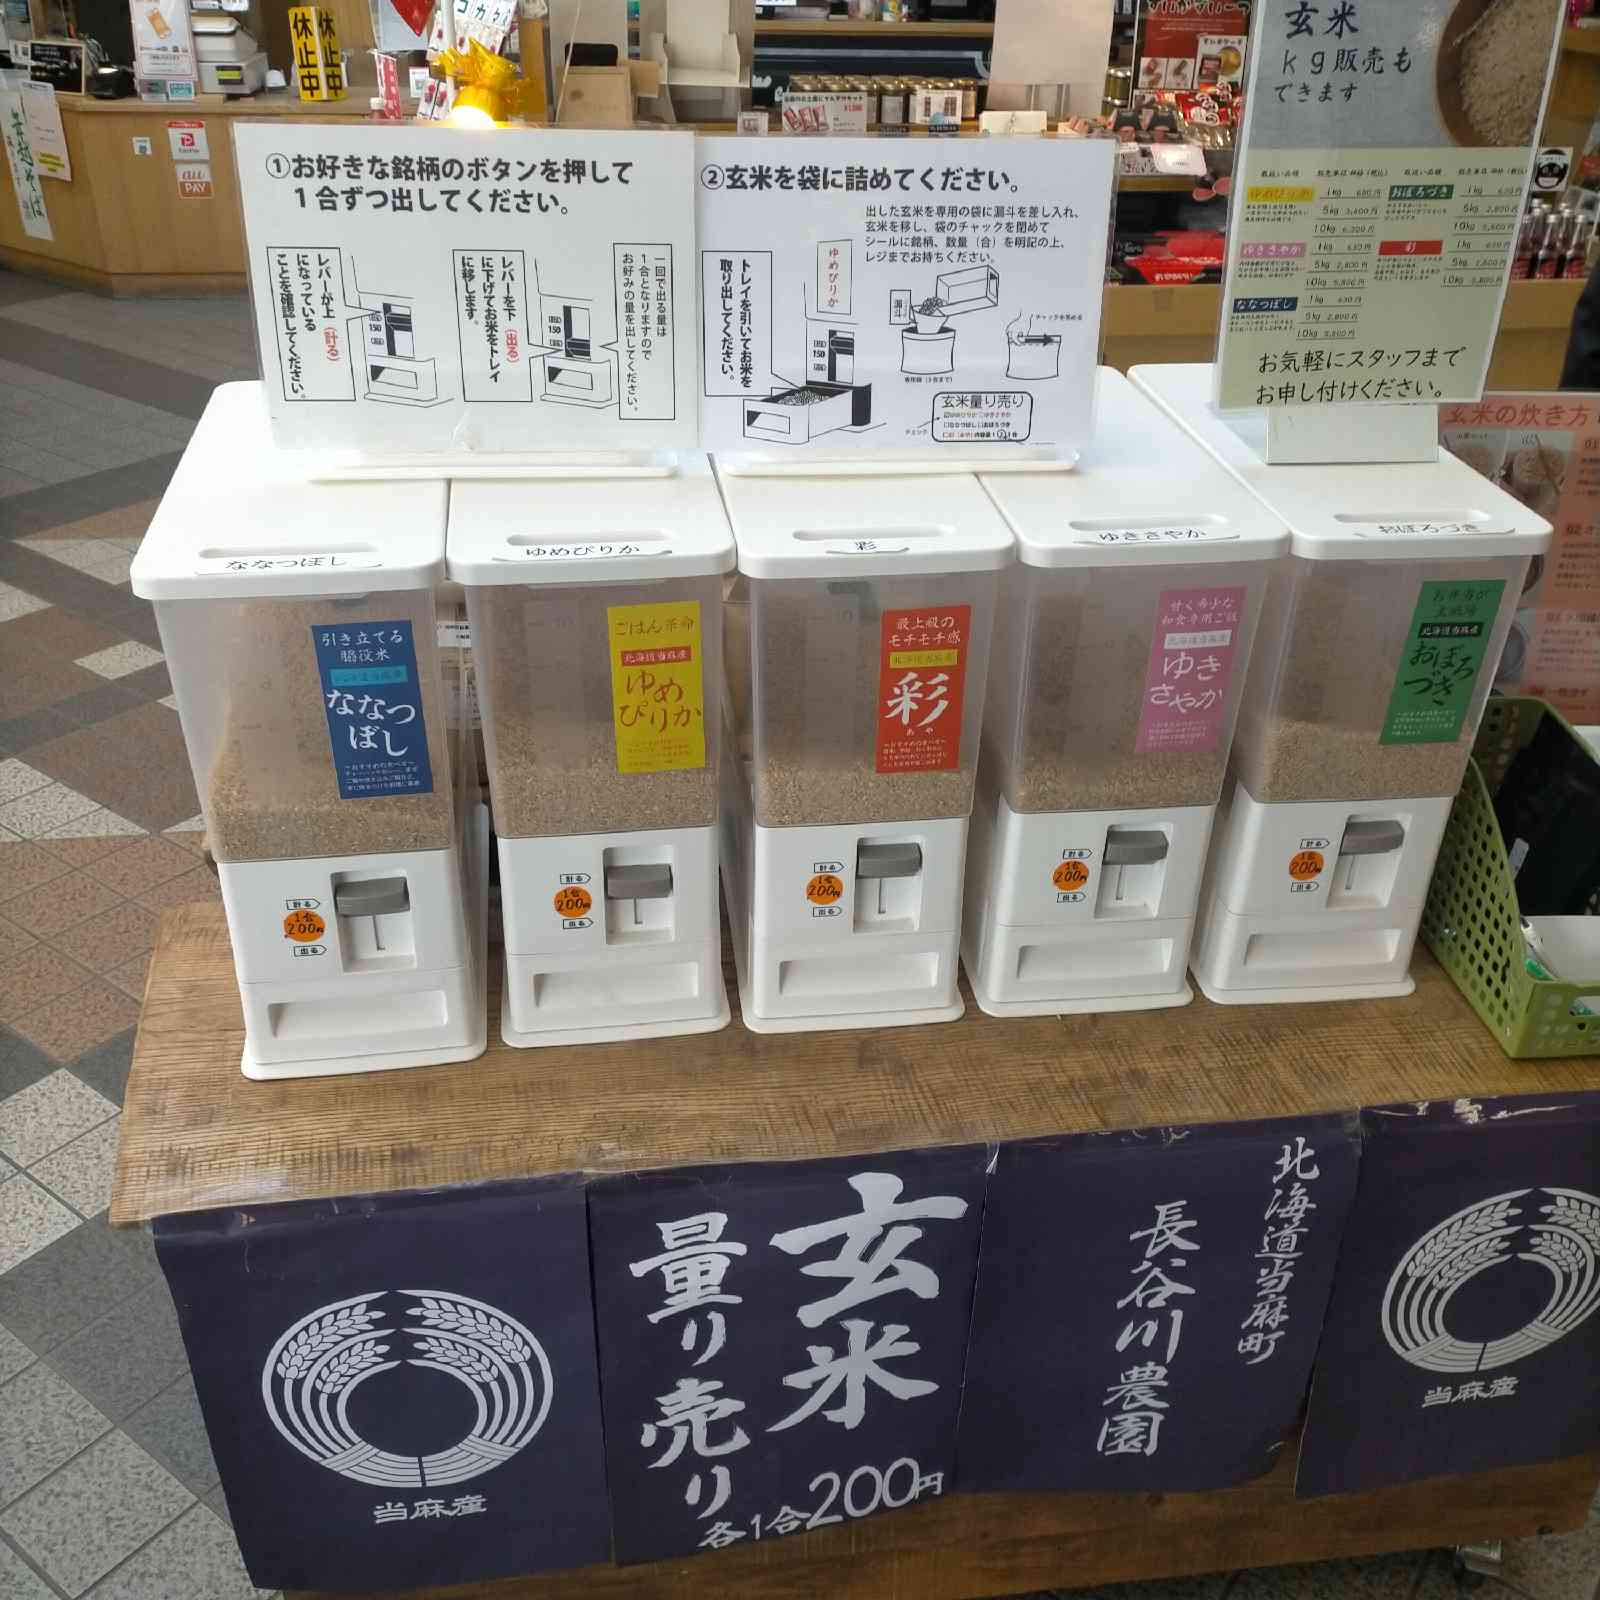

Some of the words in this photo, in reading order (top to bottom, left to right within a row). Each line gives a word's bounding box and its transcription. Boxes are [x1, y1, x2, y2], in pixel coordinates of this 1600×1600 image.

[1285, 1, 1359, 39] 玄米
[293, 13, 323, 96] 休止中
[318, 13, 344, 96] 休止中
[1274, 82, 1358, 102] できます
[865, 251, 996, 264] レジまでお持ちください。
[298, 254, 317, 332] になっている
[719, 259, 735, 381] 取り出してください。
[813, 350, 825, 358] 150
[1258, 346, 1467, 375] お気軽にスタッフまで
[942, 395, 1024, 409] 玄米量り売り
[1255, 377, 1442, 404] お申し付けください。
[853, 540, 876, 551] 彩
[1099, 528, 1208, 543] ゆきさやか
[225, 556, 348, 572] ななつぼし
[320, 630, 404, 647] 引き立てる
[889, 630, 961, 647] モチモチ感
[1163, 651, 1222, 681] ゆき
[1409, 641, 1475, 681] おぼろ
[626, 670, 684, 704] ゆめ
[884, 671, 950, 727] 彩
[1150, 683, 1224, 714] さやか
[1403, 670, 1456, 706] づき
[326, 688, 416, 725] ななつ
[619, 700, 702, 733] ぴりか
[349, 724, 409, 757] ぼし
[1237, 1136, 1320, 1365] 北海道当麻町
[766, 1171, 969, 1435] 玄米
[1096, 1200, 1200, 1456] 長谷川農園
[629, 1211, 750, 1522] 量り売り
[1421, 1375, 1519, 1408] 当麻産
[373, 1494, 488, 1525] 当麻産
[698, 1457, 945, 1550] 各1合200円
